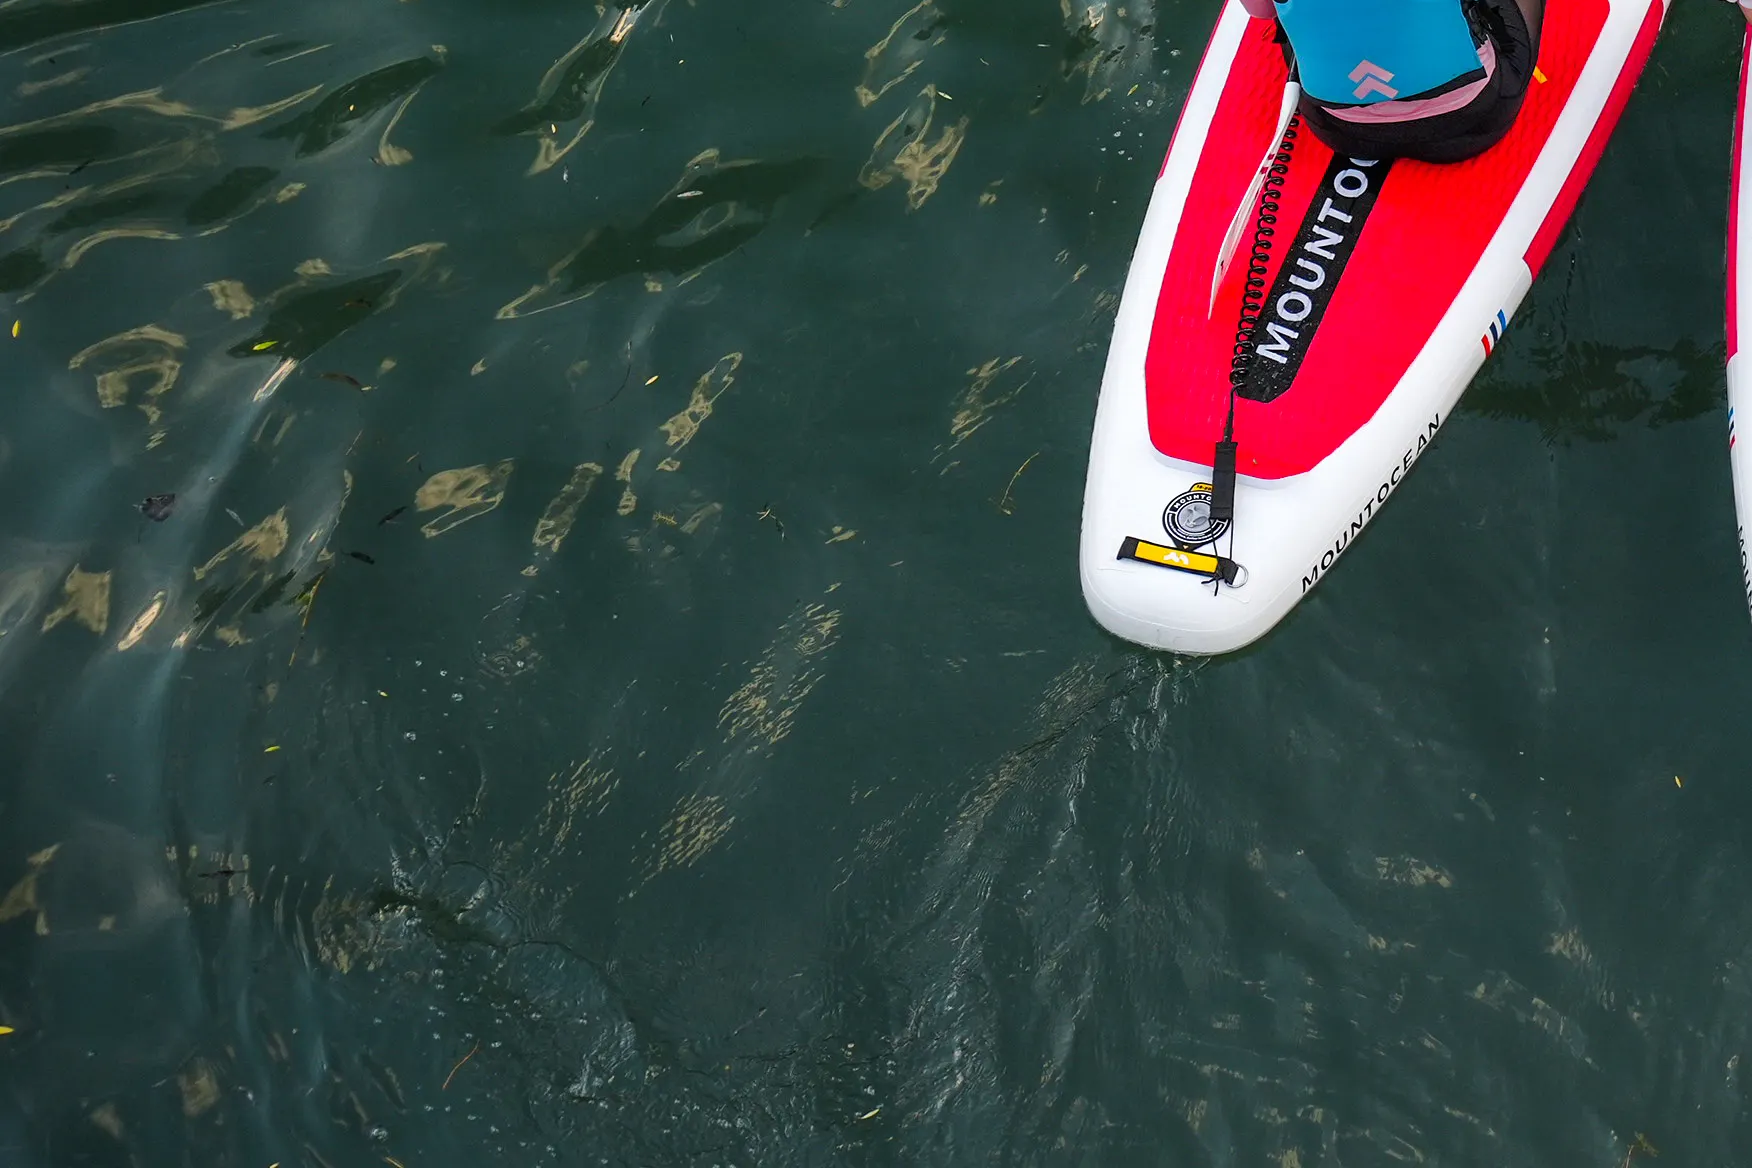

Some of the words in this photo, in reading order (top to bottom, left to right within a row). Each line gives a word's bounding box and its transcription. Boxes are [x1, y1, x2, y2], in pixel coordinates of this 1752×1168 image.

[1256, 157, 1380, 364] MOUNTO
[1174, 493, 1212, 509] MOUNTO
[1301, 413, 1440, 593] MOUNTOCEAN
